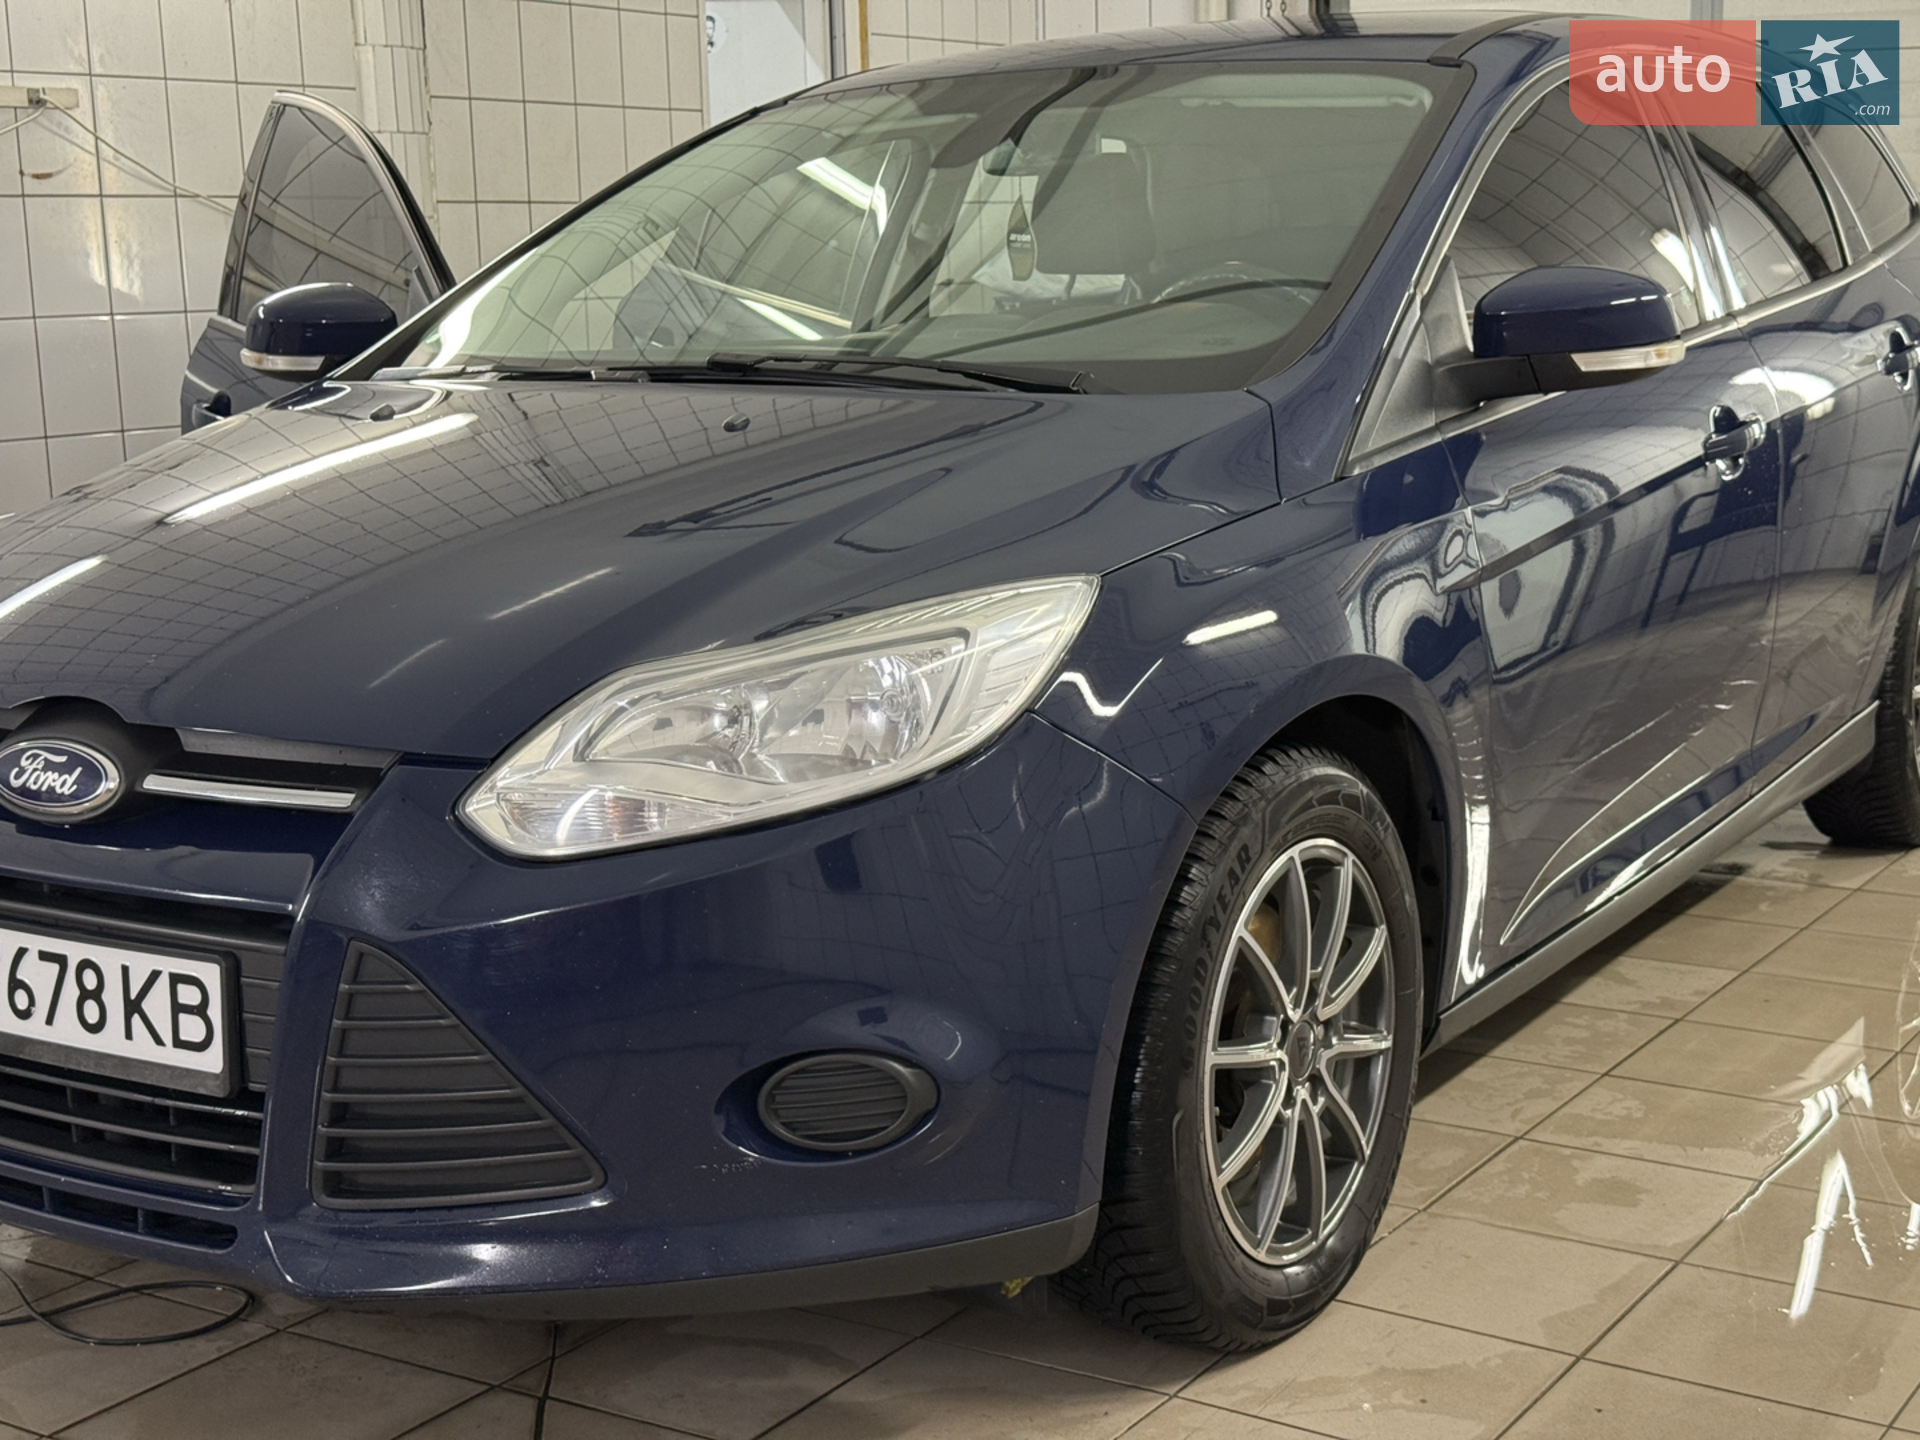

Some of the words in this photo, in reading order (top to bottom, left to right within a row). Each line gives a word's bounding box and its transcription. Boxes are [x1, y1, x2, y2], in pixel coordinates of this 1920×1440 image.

[9, 749, 83, 796] Ford
[7, 946, 107, 1035] 678
[121, 963, 214, 1053] KB
